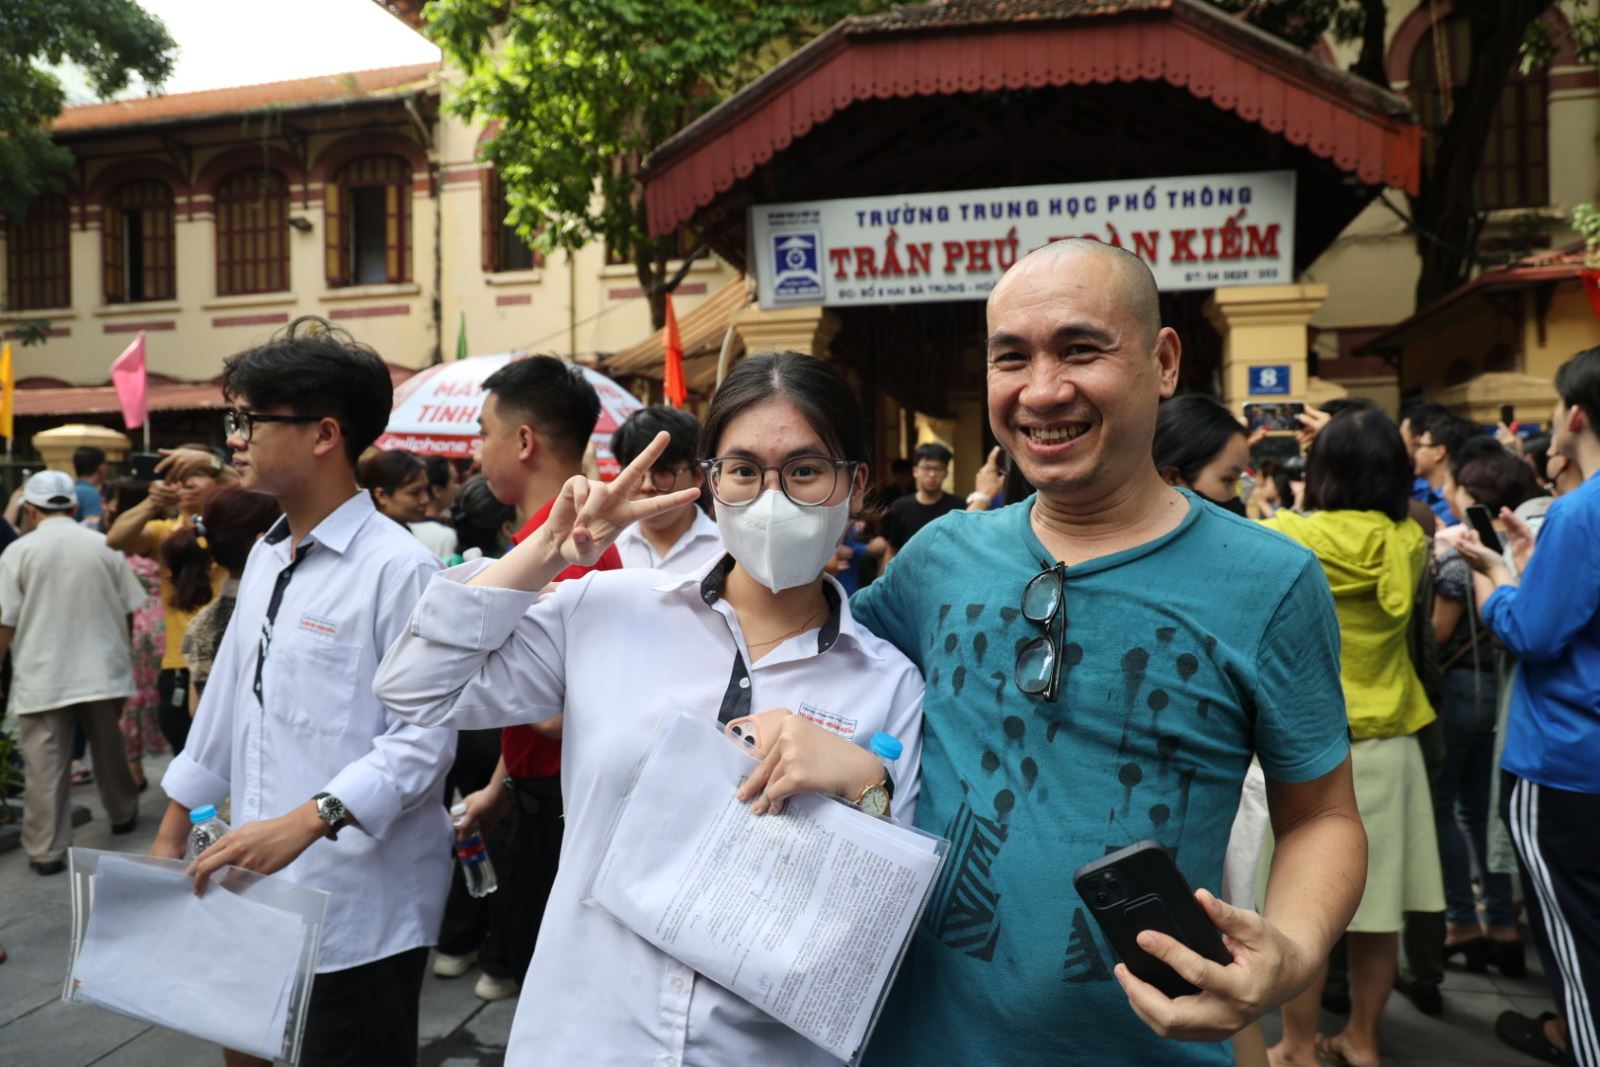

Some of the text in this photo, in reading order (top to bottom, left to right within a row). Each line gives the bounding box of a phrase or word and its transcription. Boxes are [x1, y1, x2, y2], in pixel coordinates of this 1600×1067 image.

[856, 202, 950, 227] TRƯỜNG
[960, 200, 1039, 222] TRUNG
[1050, 197, 1096, 218] HỌC
[1167, 185, 1253, 209] THÔNG
[829, 226, 933, 279] TRẦN
[943, 225, 1019, 273] PHÚ
[1169, 207, 1281, 263] KIẾM
[1260, 367, 1278, 388] 8
[417, 400, 479, 424] TÍNH
